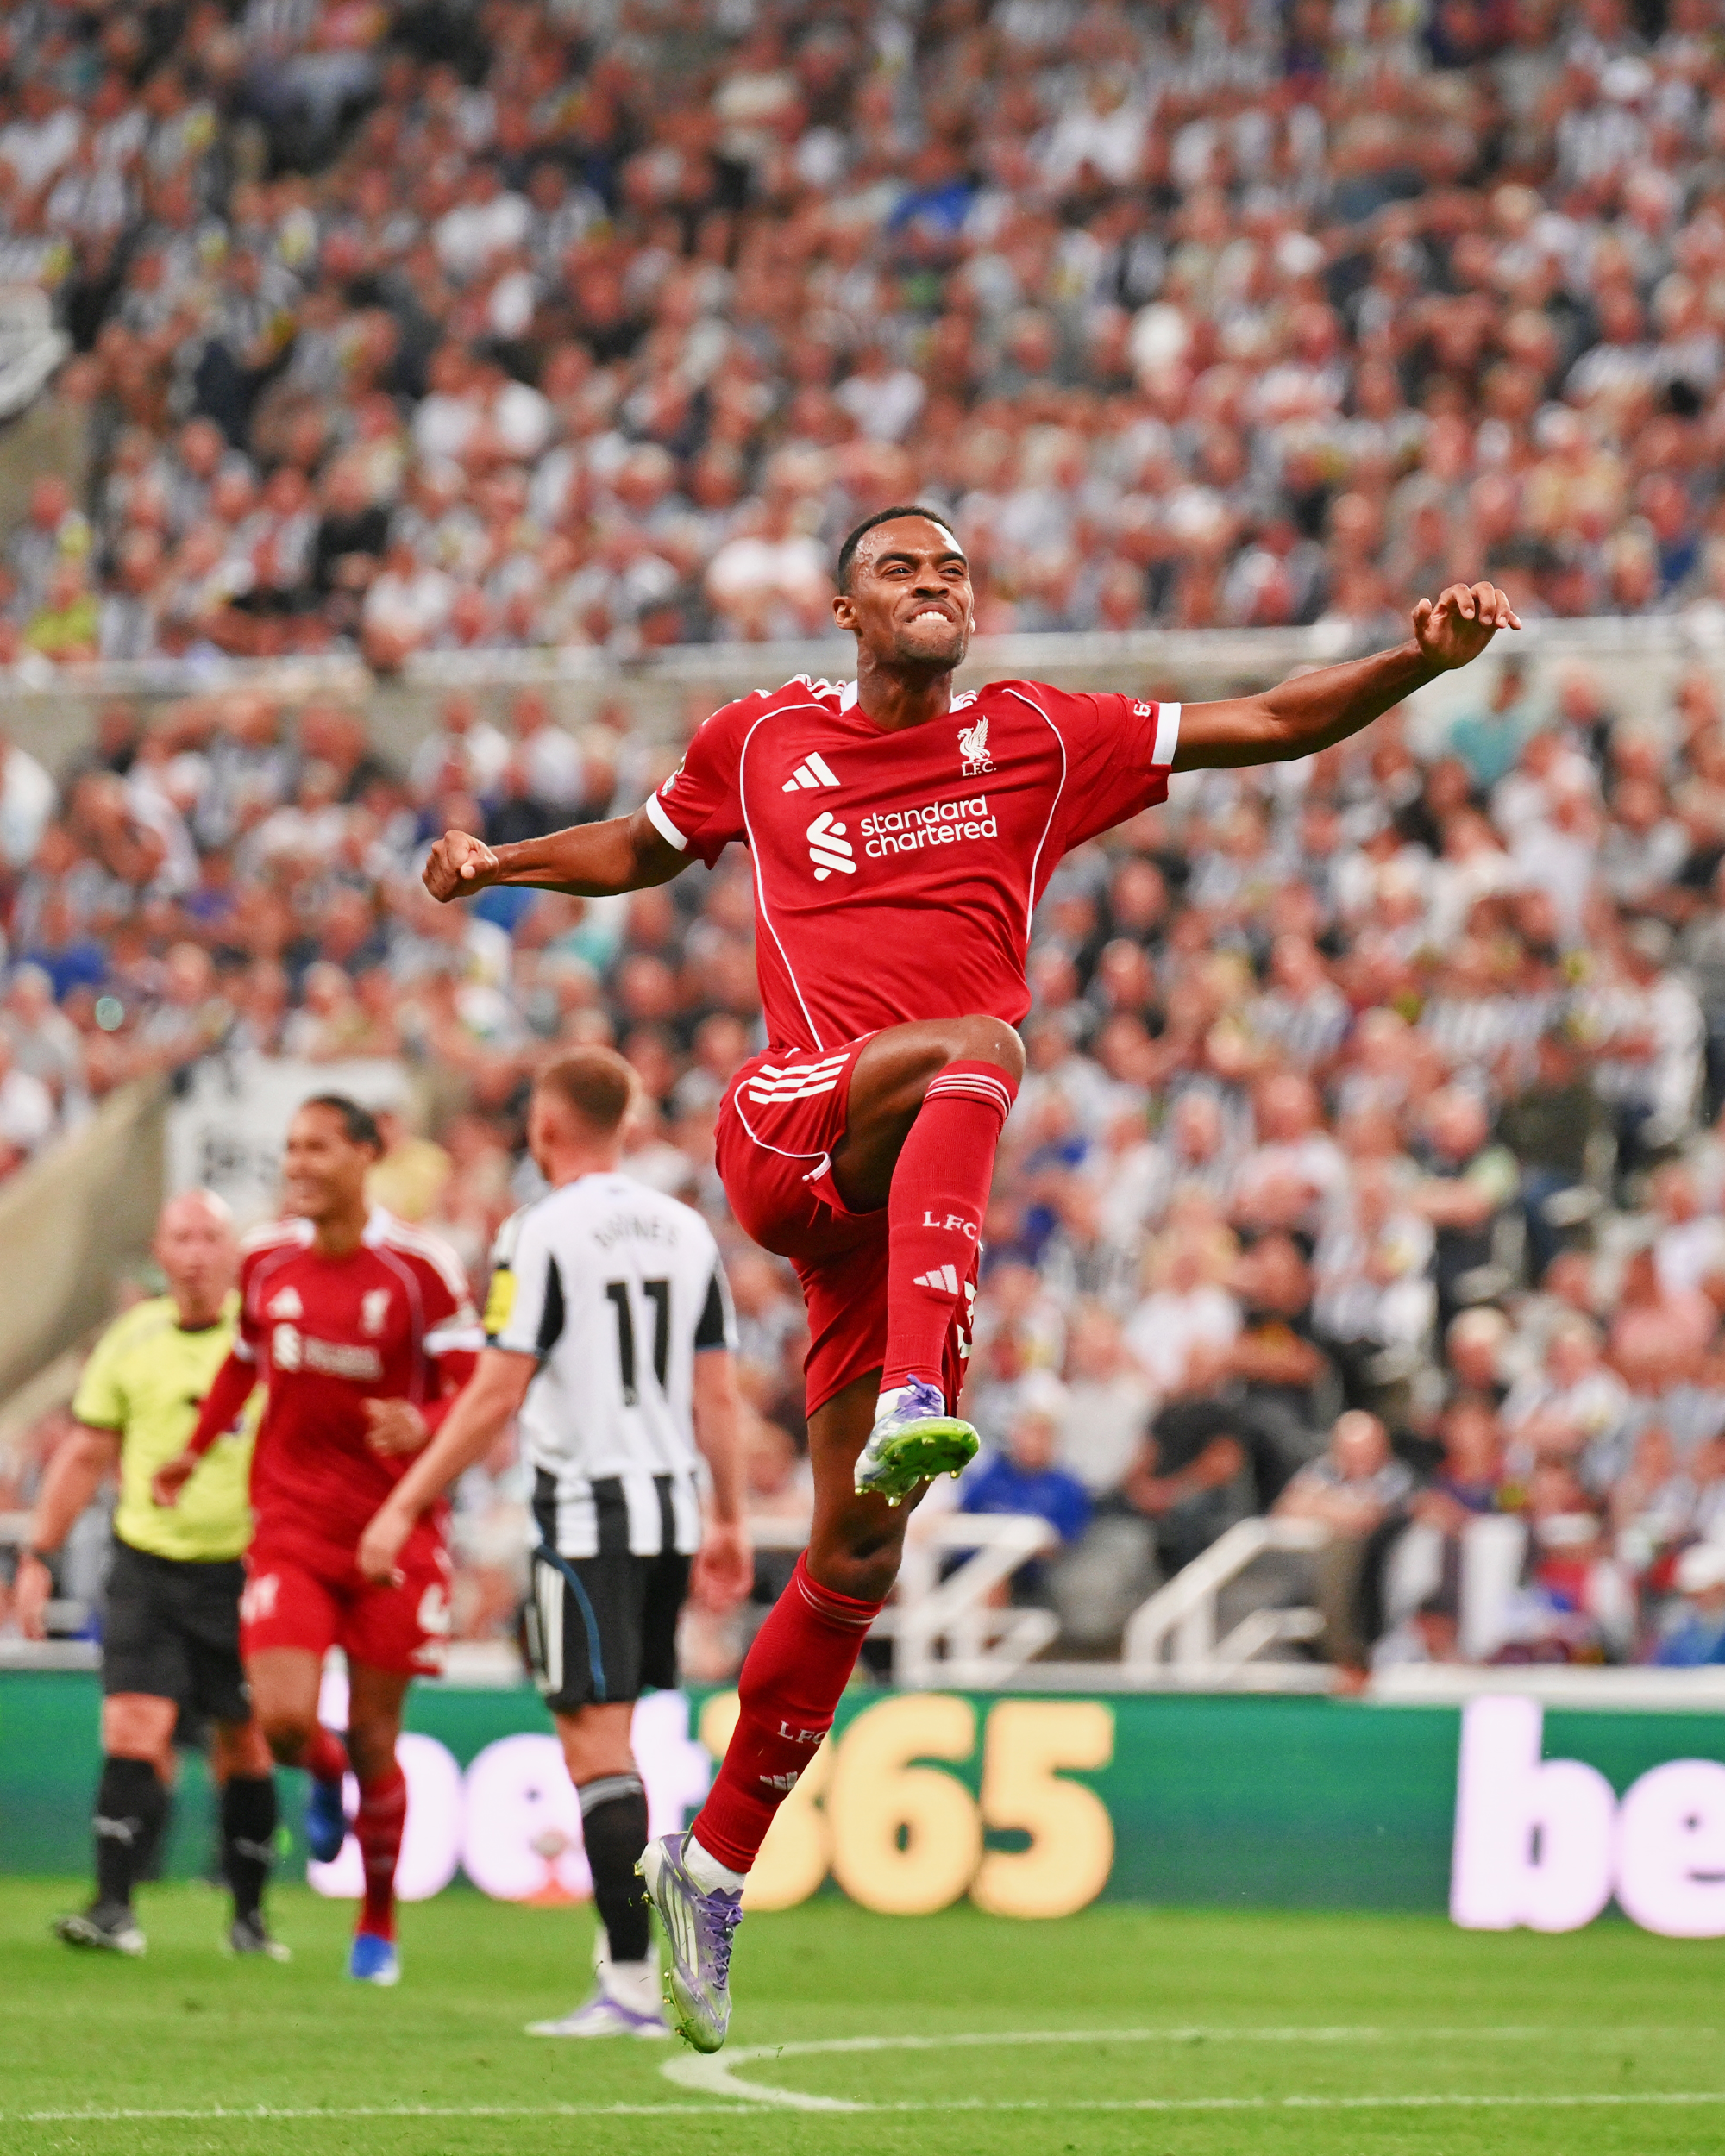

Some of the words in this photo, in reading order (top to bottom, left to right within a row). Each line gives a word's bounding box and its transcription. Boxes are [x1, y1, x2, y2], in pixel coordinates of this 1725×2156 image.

[860, 794, 988, 837] standard
[865, 814, 998, 858] chartered
[922, 1211, 978, 1240] LFC
[605, 1280, 669, 1407] 11
